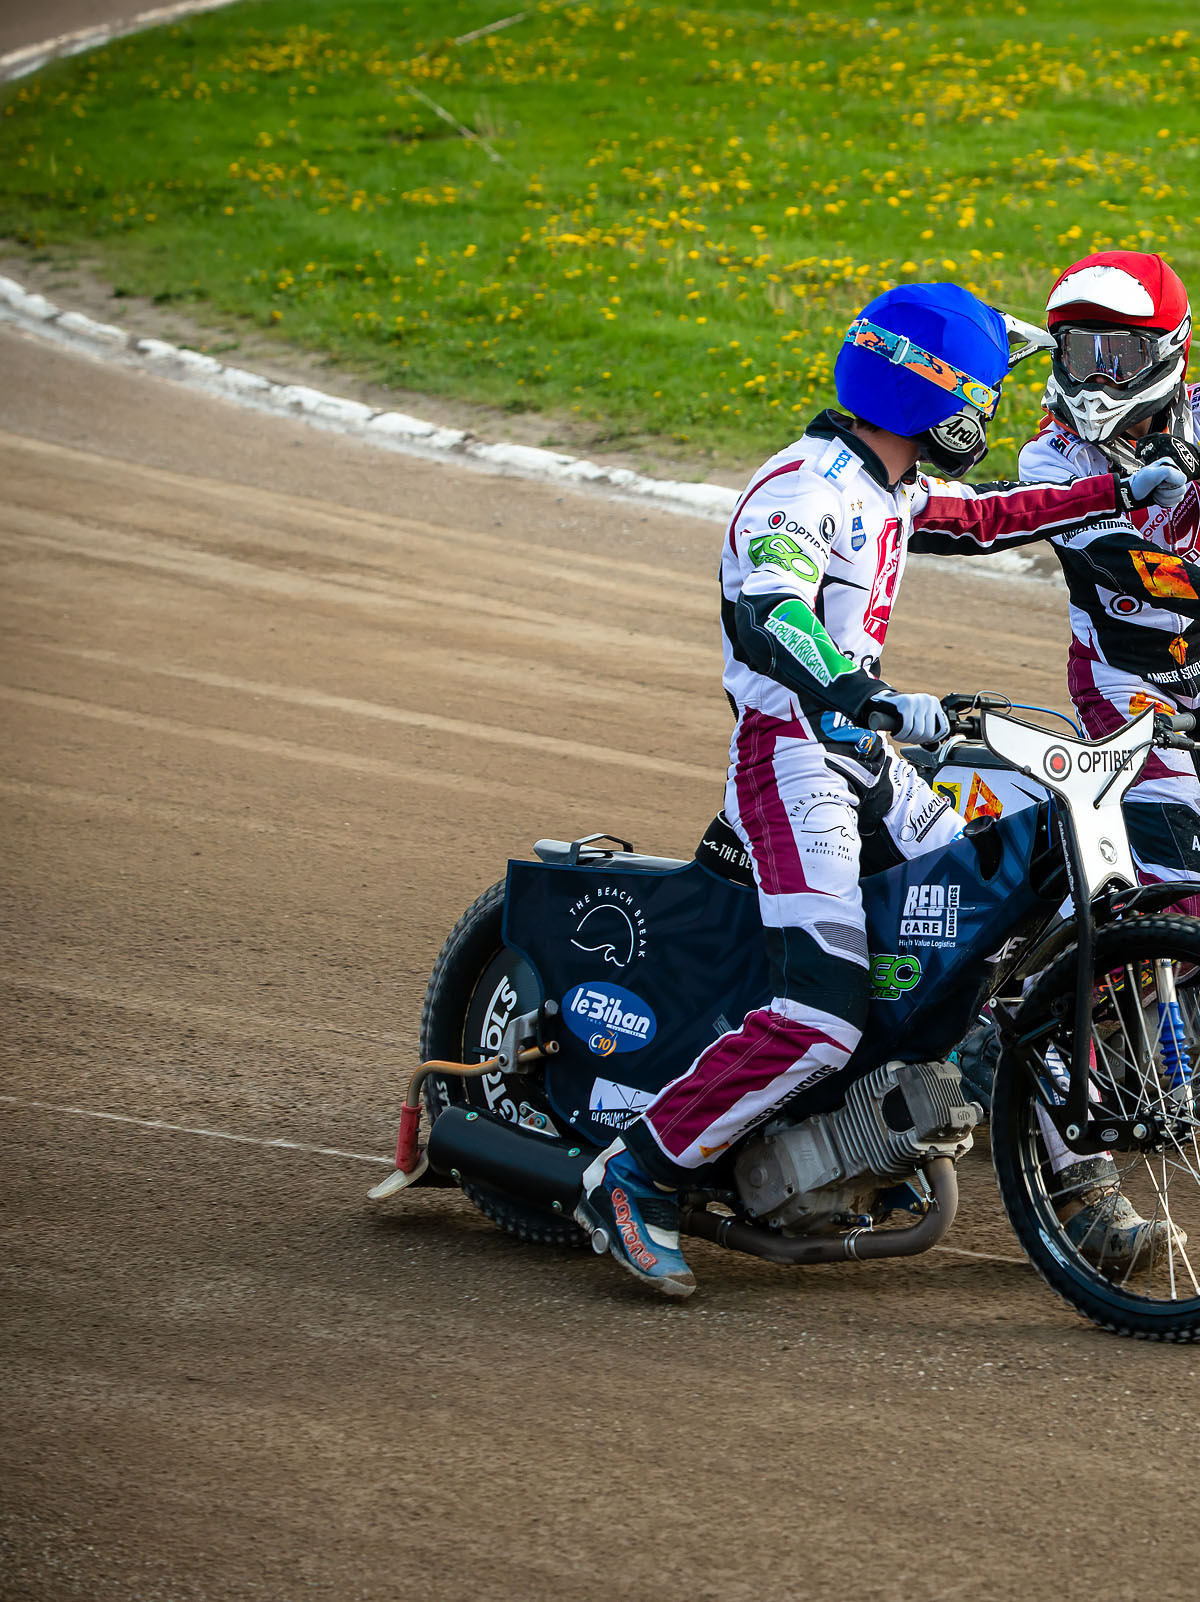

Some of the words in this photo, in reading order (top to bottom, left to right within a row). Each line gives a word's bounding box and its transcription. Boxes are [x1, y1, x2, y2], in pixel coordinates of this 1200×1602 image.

[934, 417, 979, 445] Arai
[1147, 670, 1182, 684] AMBER
[1077, 749, 1134, 773] OPTIBET
[718, 843, 740, 863] THE
[738, 852, 754, 870] BE
[902, 884, 945, 917] RED
[569, 894, 591, 916] THE
[597, 886, 634, 906] BEACH
[634, 909, 647, 958] BREAK
[904, 921, 940, 934] CARE
[914, 939, 930, 947] Value
[930, 940, 956, 950] Logistics
[591, 1034, 612, 1051] C10
